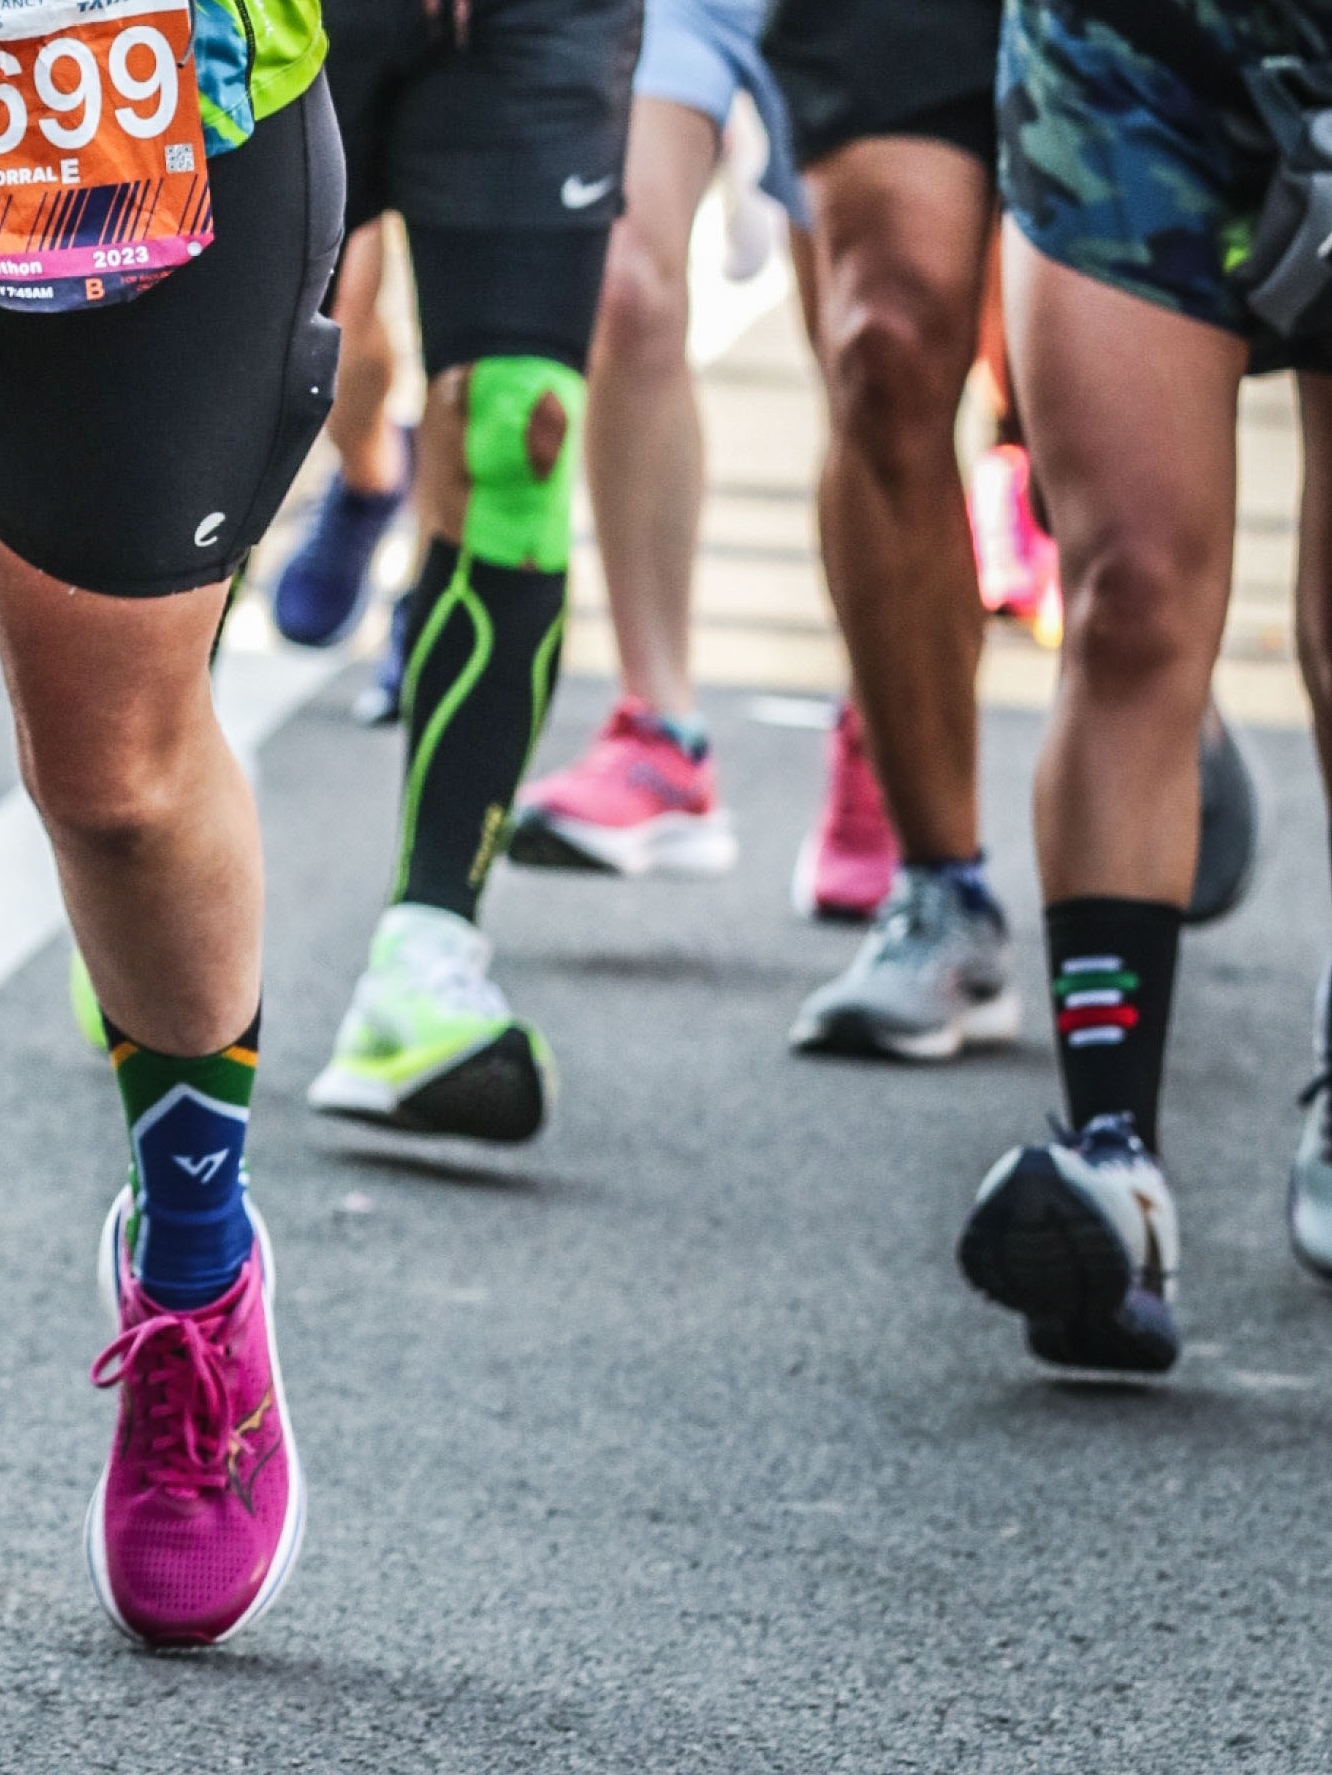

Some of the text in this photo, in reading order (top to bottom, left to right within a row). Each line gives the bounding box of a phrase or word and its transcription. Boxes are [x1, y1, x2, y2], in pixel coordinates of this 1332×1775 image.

[60, 158, 81, 185] E
[92, 245, 150, 269] 2023
[84, 277, 106, 302] B
